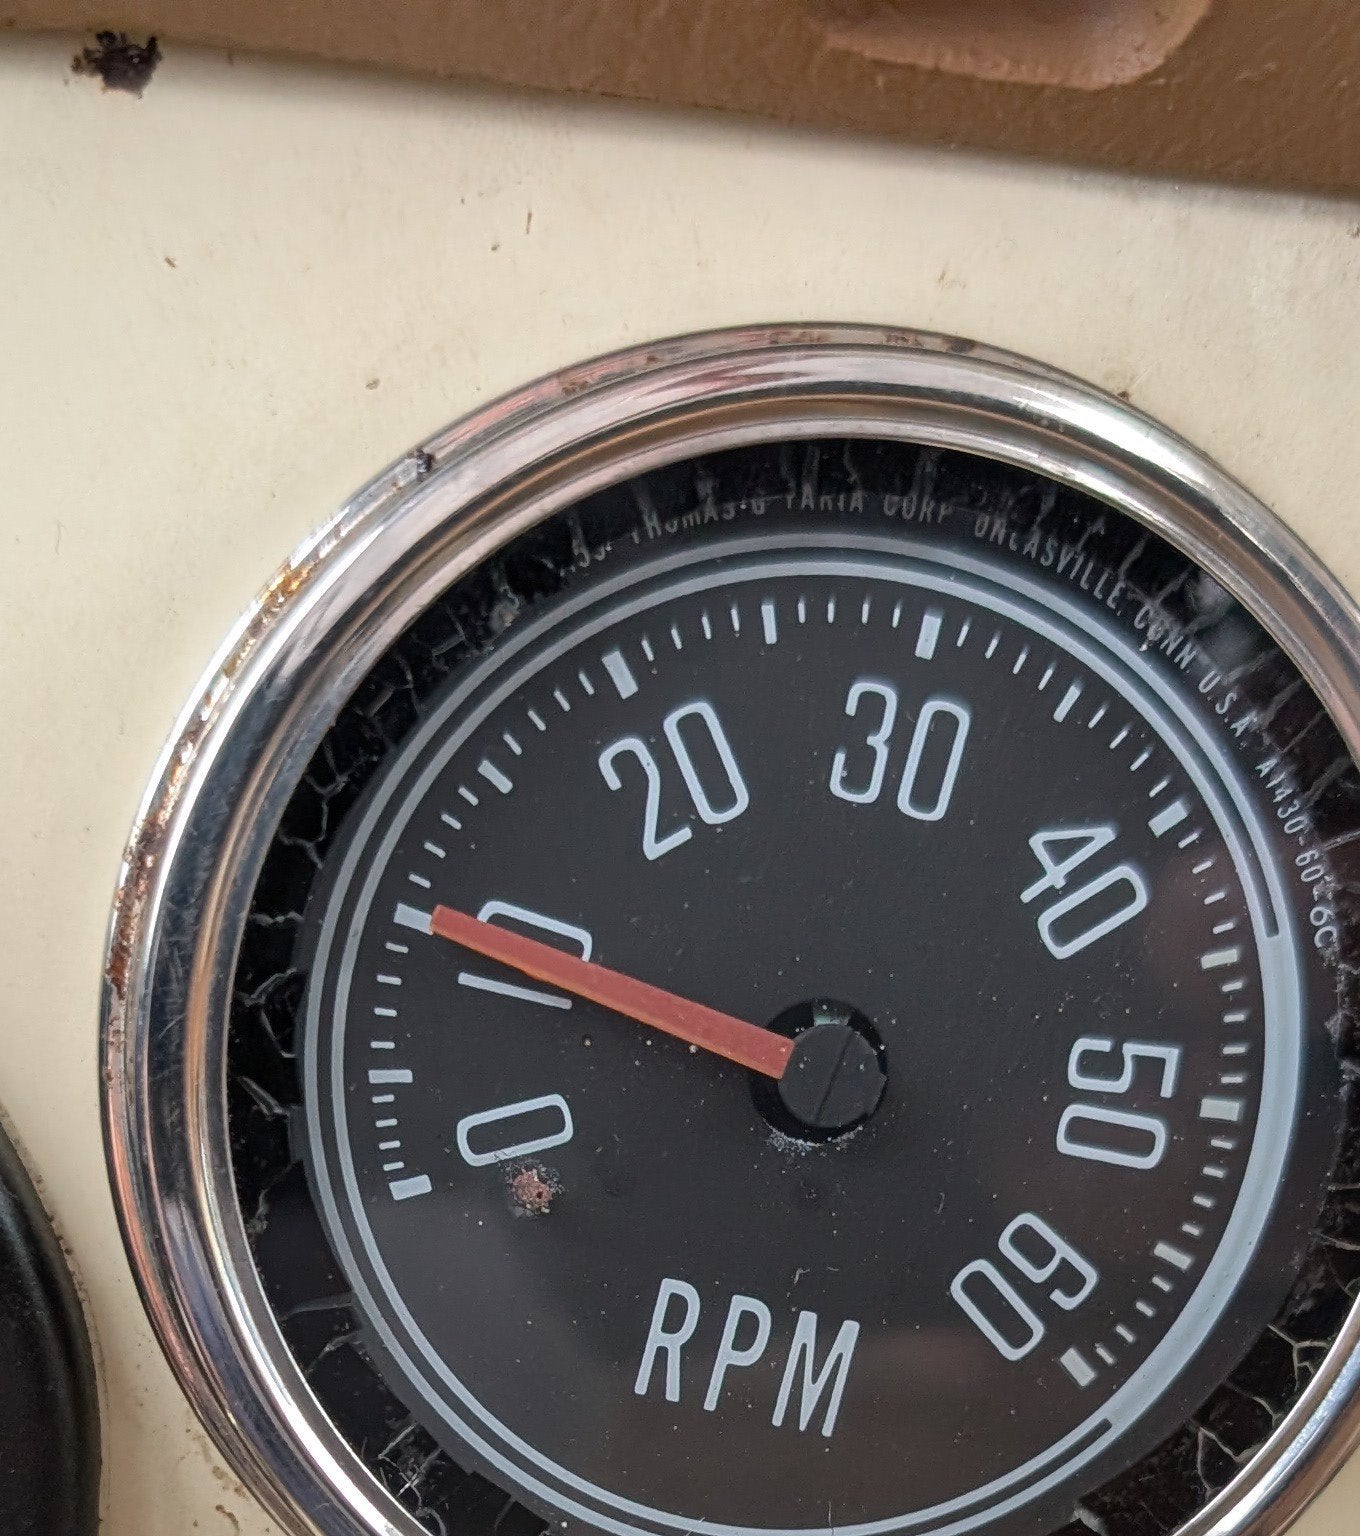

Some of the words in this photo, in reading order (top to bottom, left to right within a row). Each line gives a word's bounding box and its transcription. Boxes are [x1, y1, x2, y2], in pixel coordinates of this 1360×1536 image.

[786, 484, 864, 514] ARIA
[597, 701, 750, 861] 20
[829, 681, 971, 822] 30
[1019, 826, 1148, 960] 40
[456, 1093, 574, 1167] 0
[1056, 1037, 1181, 1170] 50
[950, 1212, 1099, 1362] 60
[634, 1277, 861, 1438] RPM
